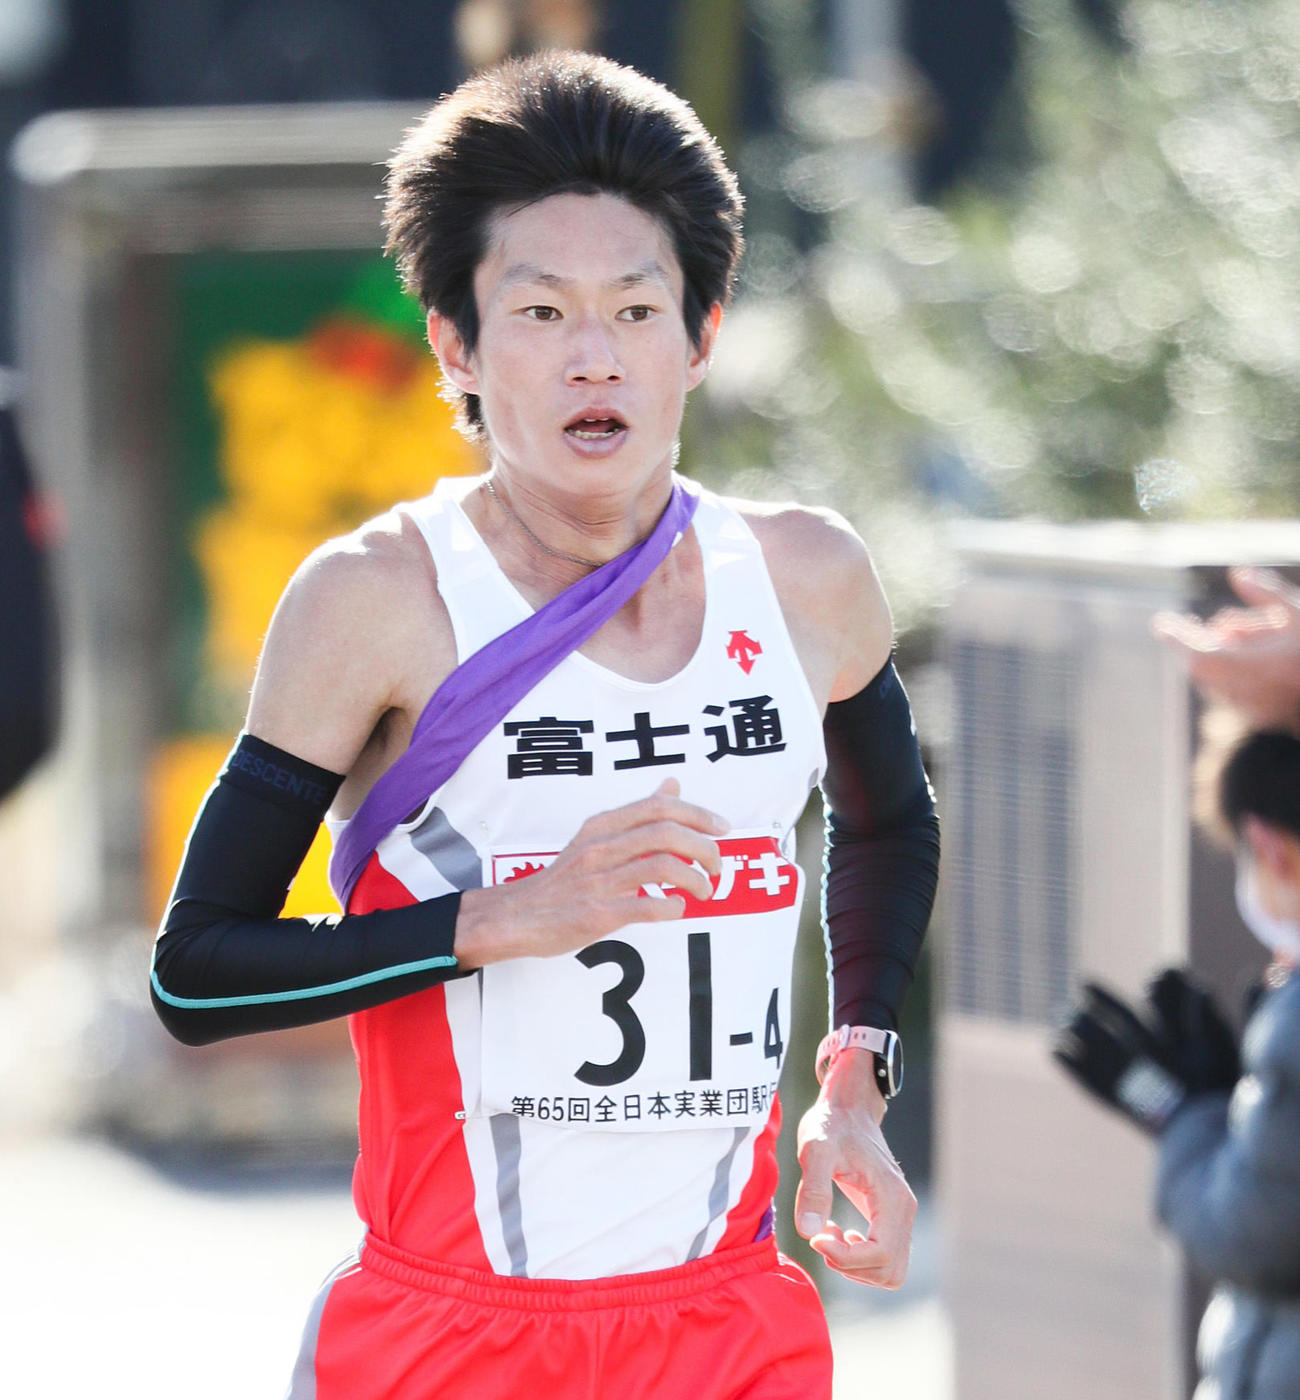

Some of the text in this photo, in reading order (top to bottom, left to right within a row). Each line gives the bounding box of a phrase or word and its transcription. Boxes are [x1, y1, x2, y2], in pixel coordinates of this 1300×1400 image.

[503, 695, 788, 780] 富士通
[230, 748, 328, 805] DESCENTE
